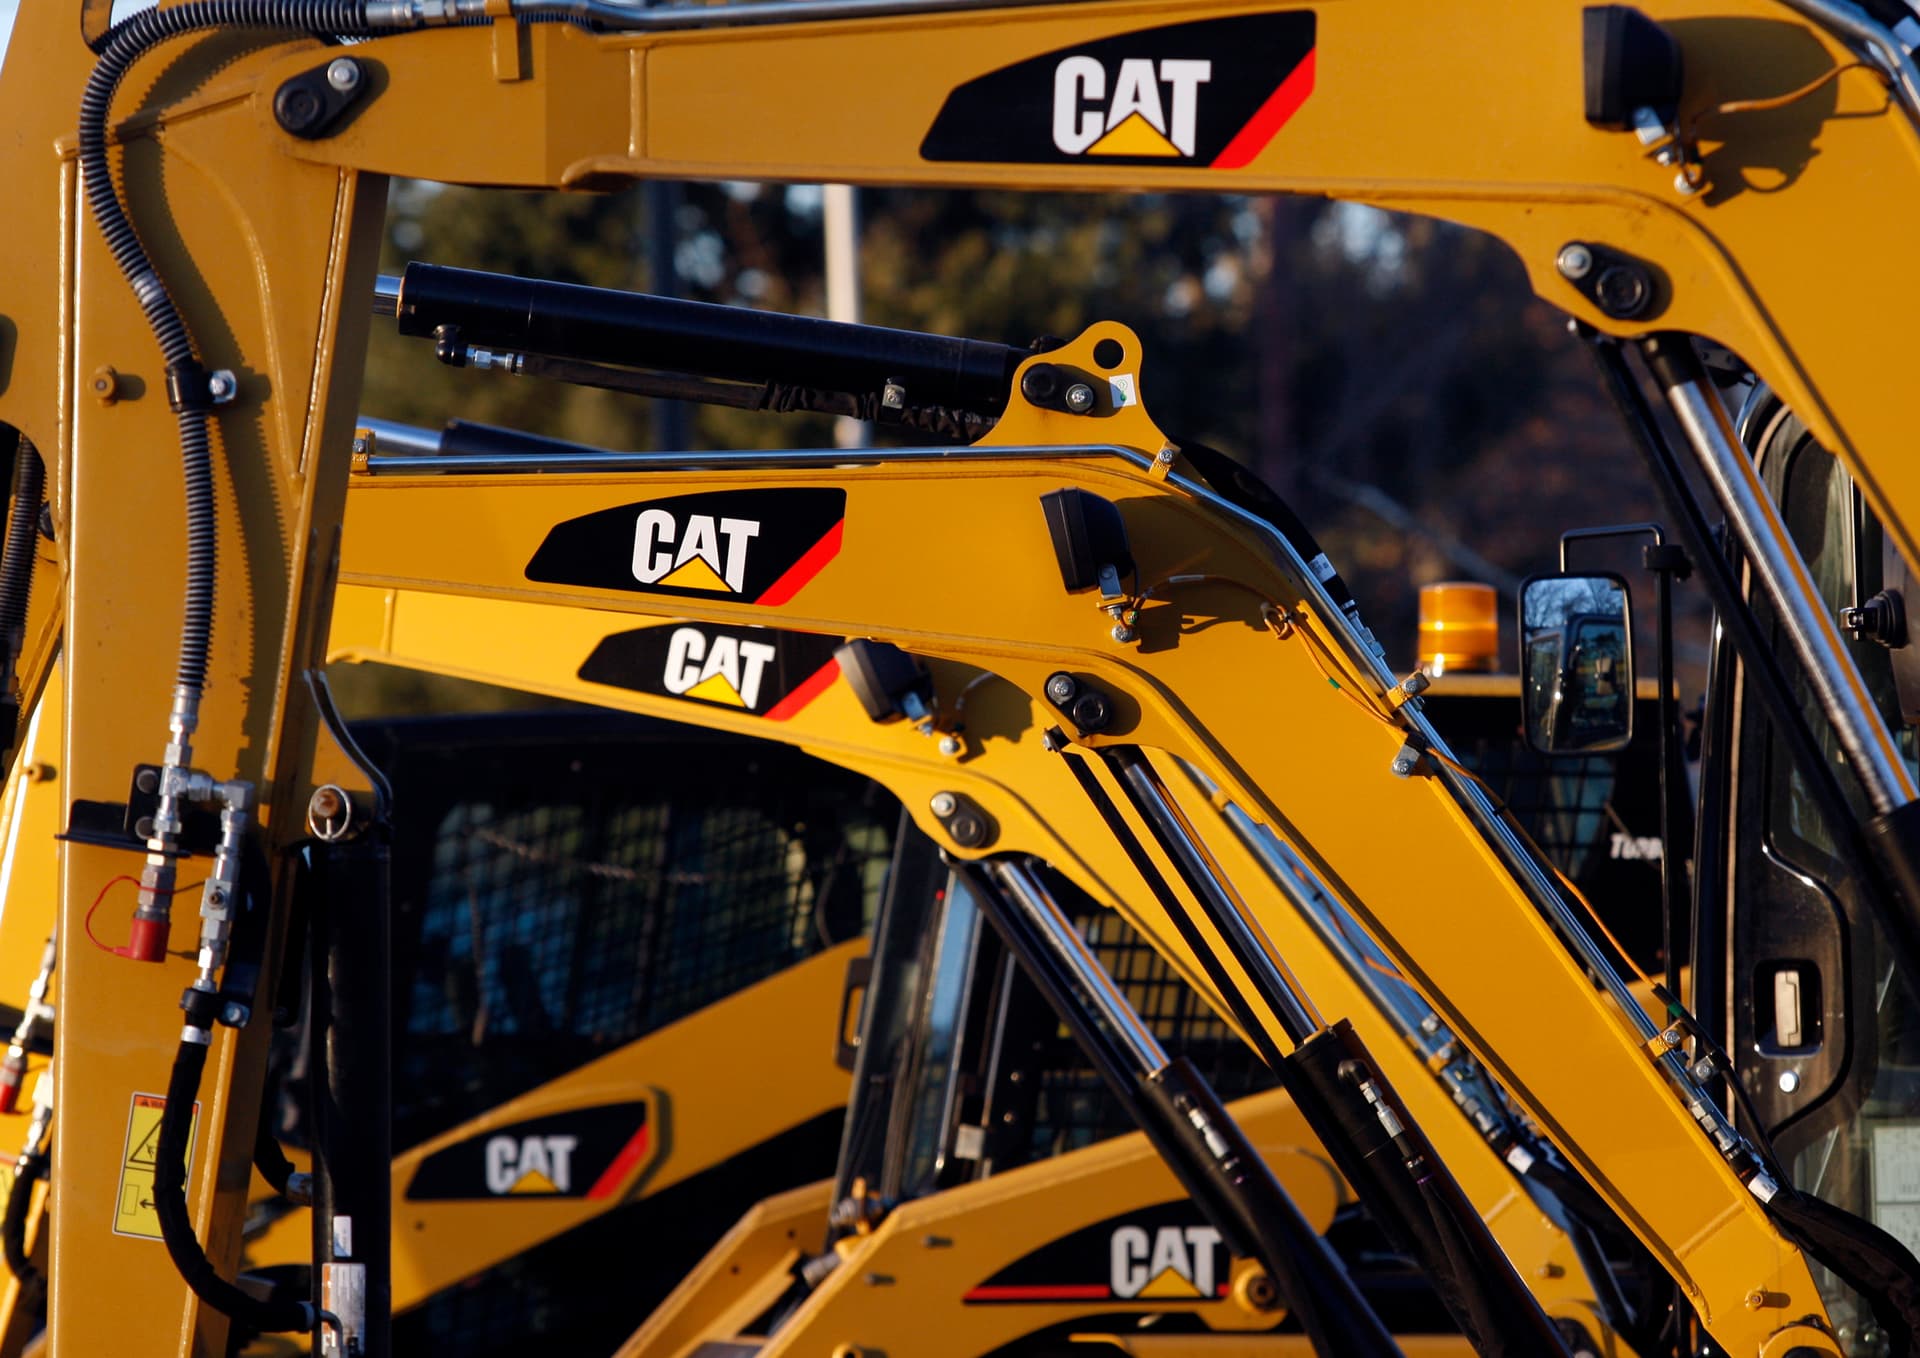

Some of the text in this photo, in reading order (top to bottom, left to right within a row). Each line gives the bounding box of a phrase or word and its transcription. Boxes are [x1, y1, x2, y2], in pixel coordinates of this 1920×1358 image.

[1053, 56, 1211, 158] CAT
[632, 509, 760, 593] CAT
[663, 627, 776, 709] CAT
[486, 1136, 576, 1193] CAT
[1111, 1226, 1222, 1298] CAT
